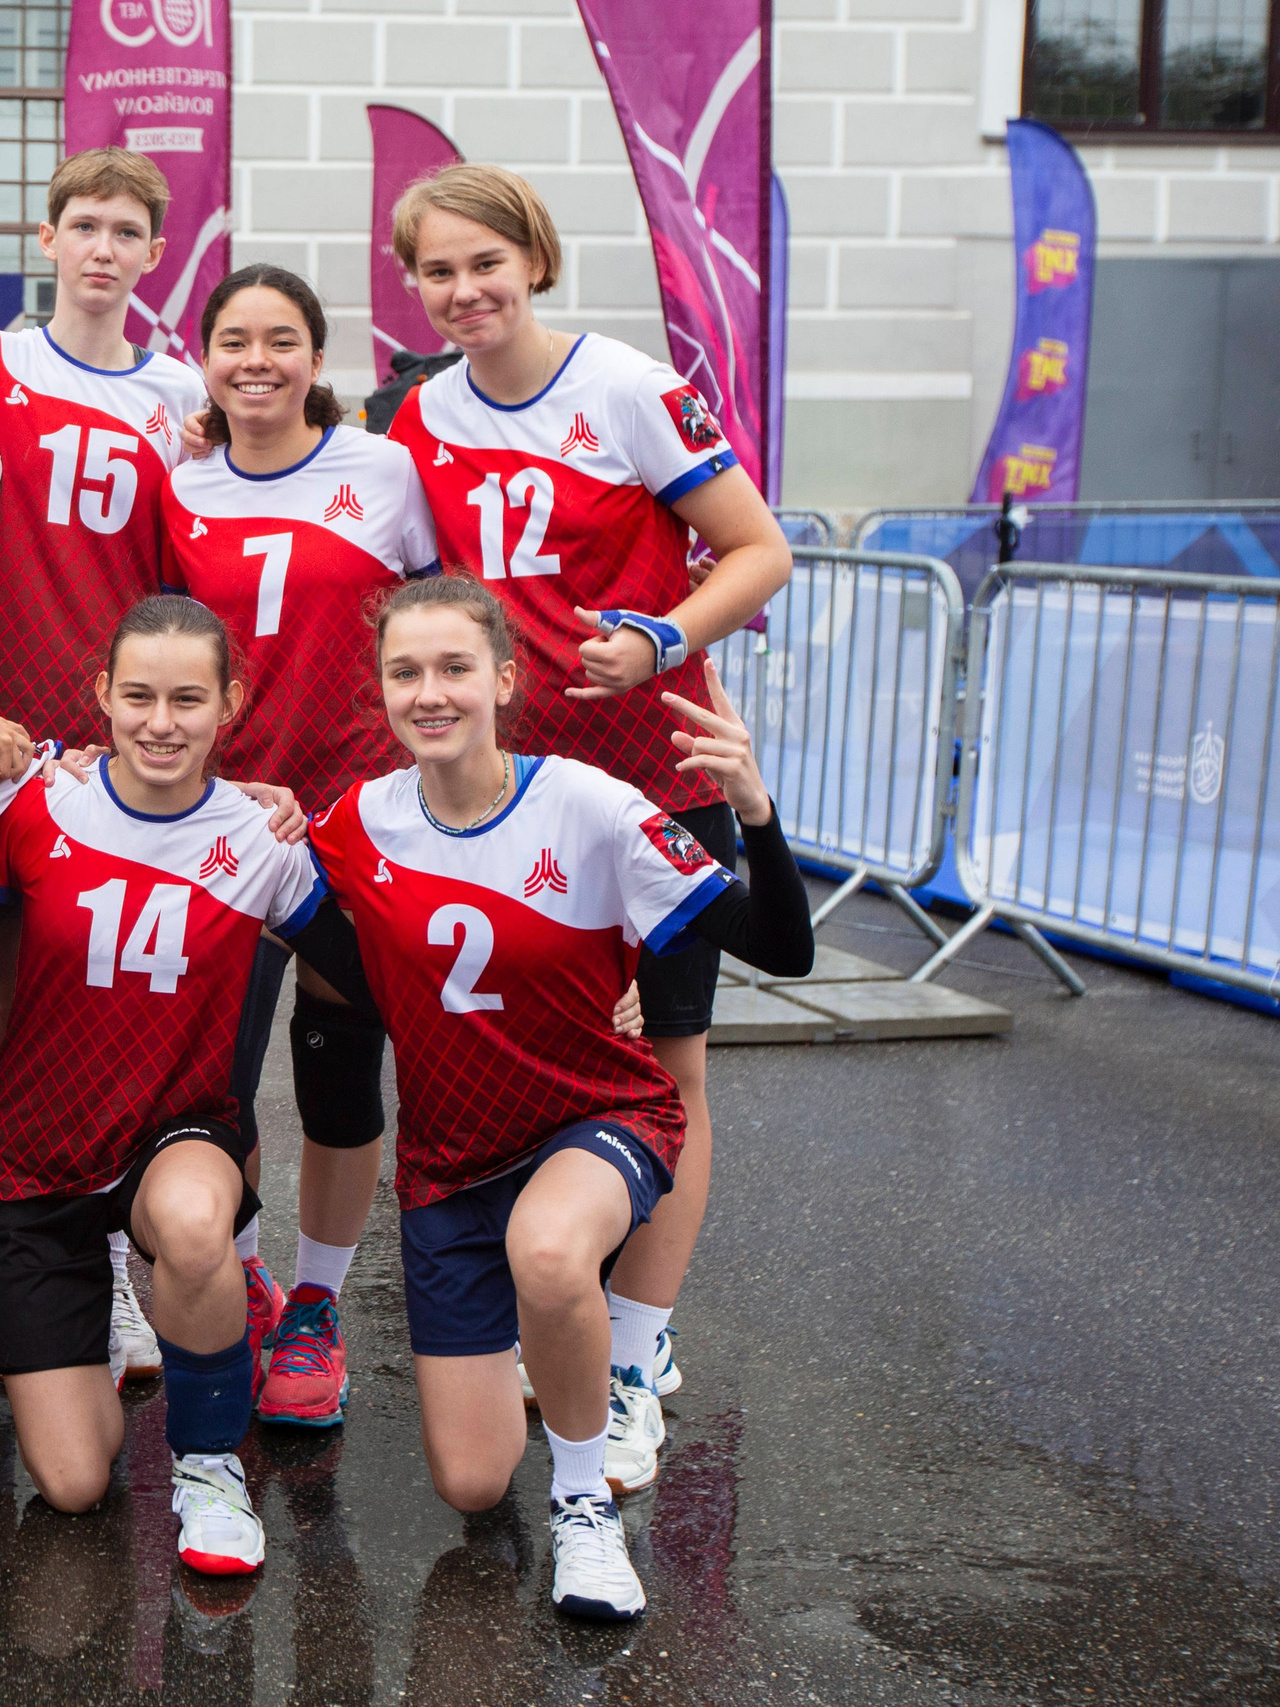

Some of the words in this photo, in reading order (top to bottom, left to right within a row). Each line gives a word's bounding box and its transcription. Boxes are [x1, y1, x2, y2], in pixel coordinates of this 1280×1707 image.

[38, 423, 140, 535] 15
[466, 467, 561, 579] 12
[242, 532, 294, 637] 7
[76, 877, 192, 994] 14
[427, 903, 505, 1014] 2
